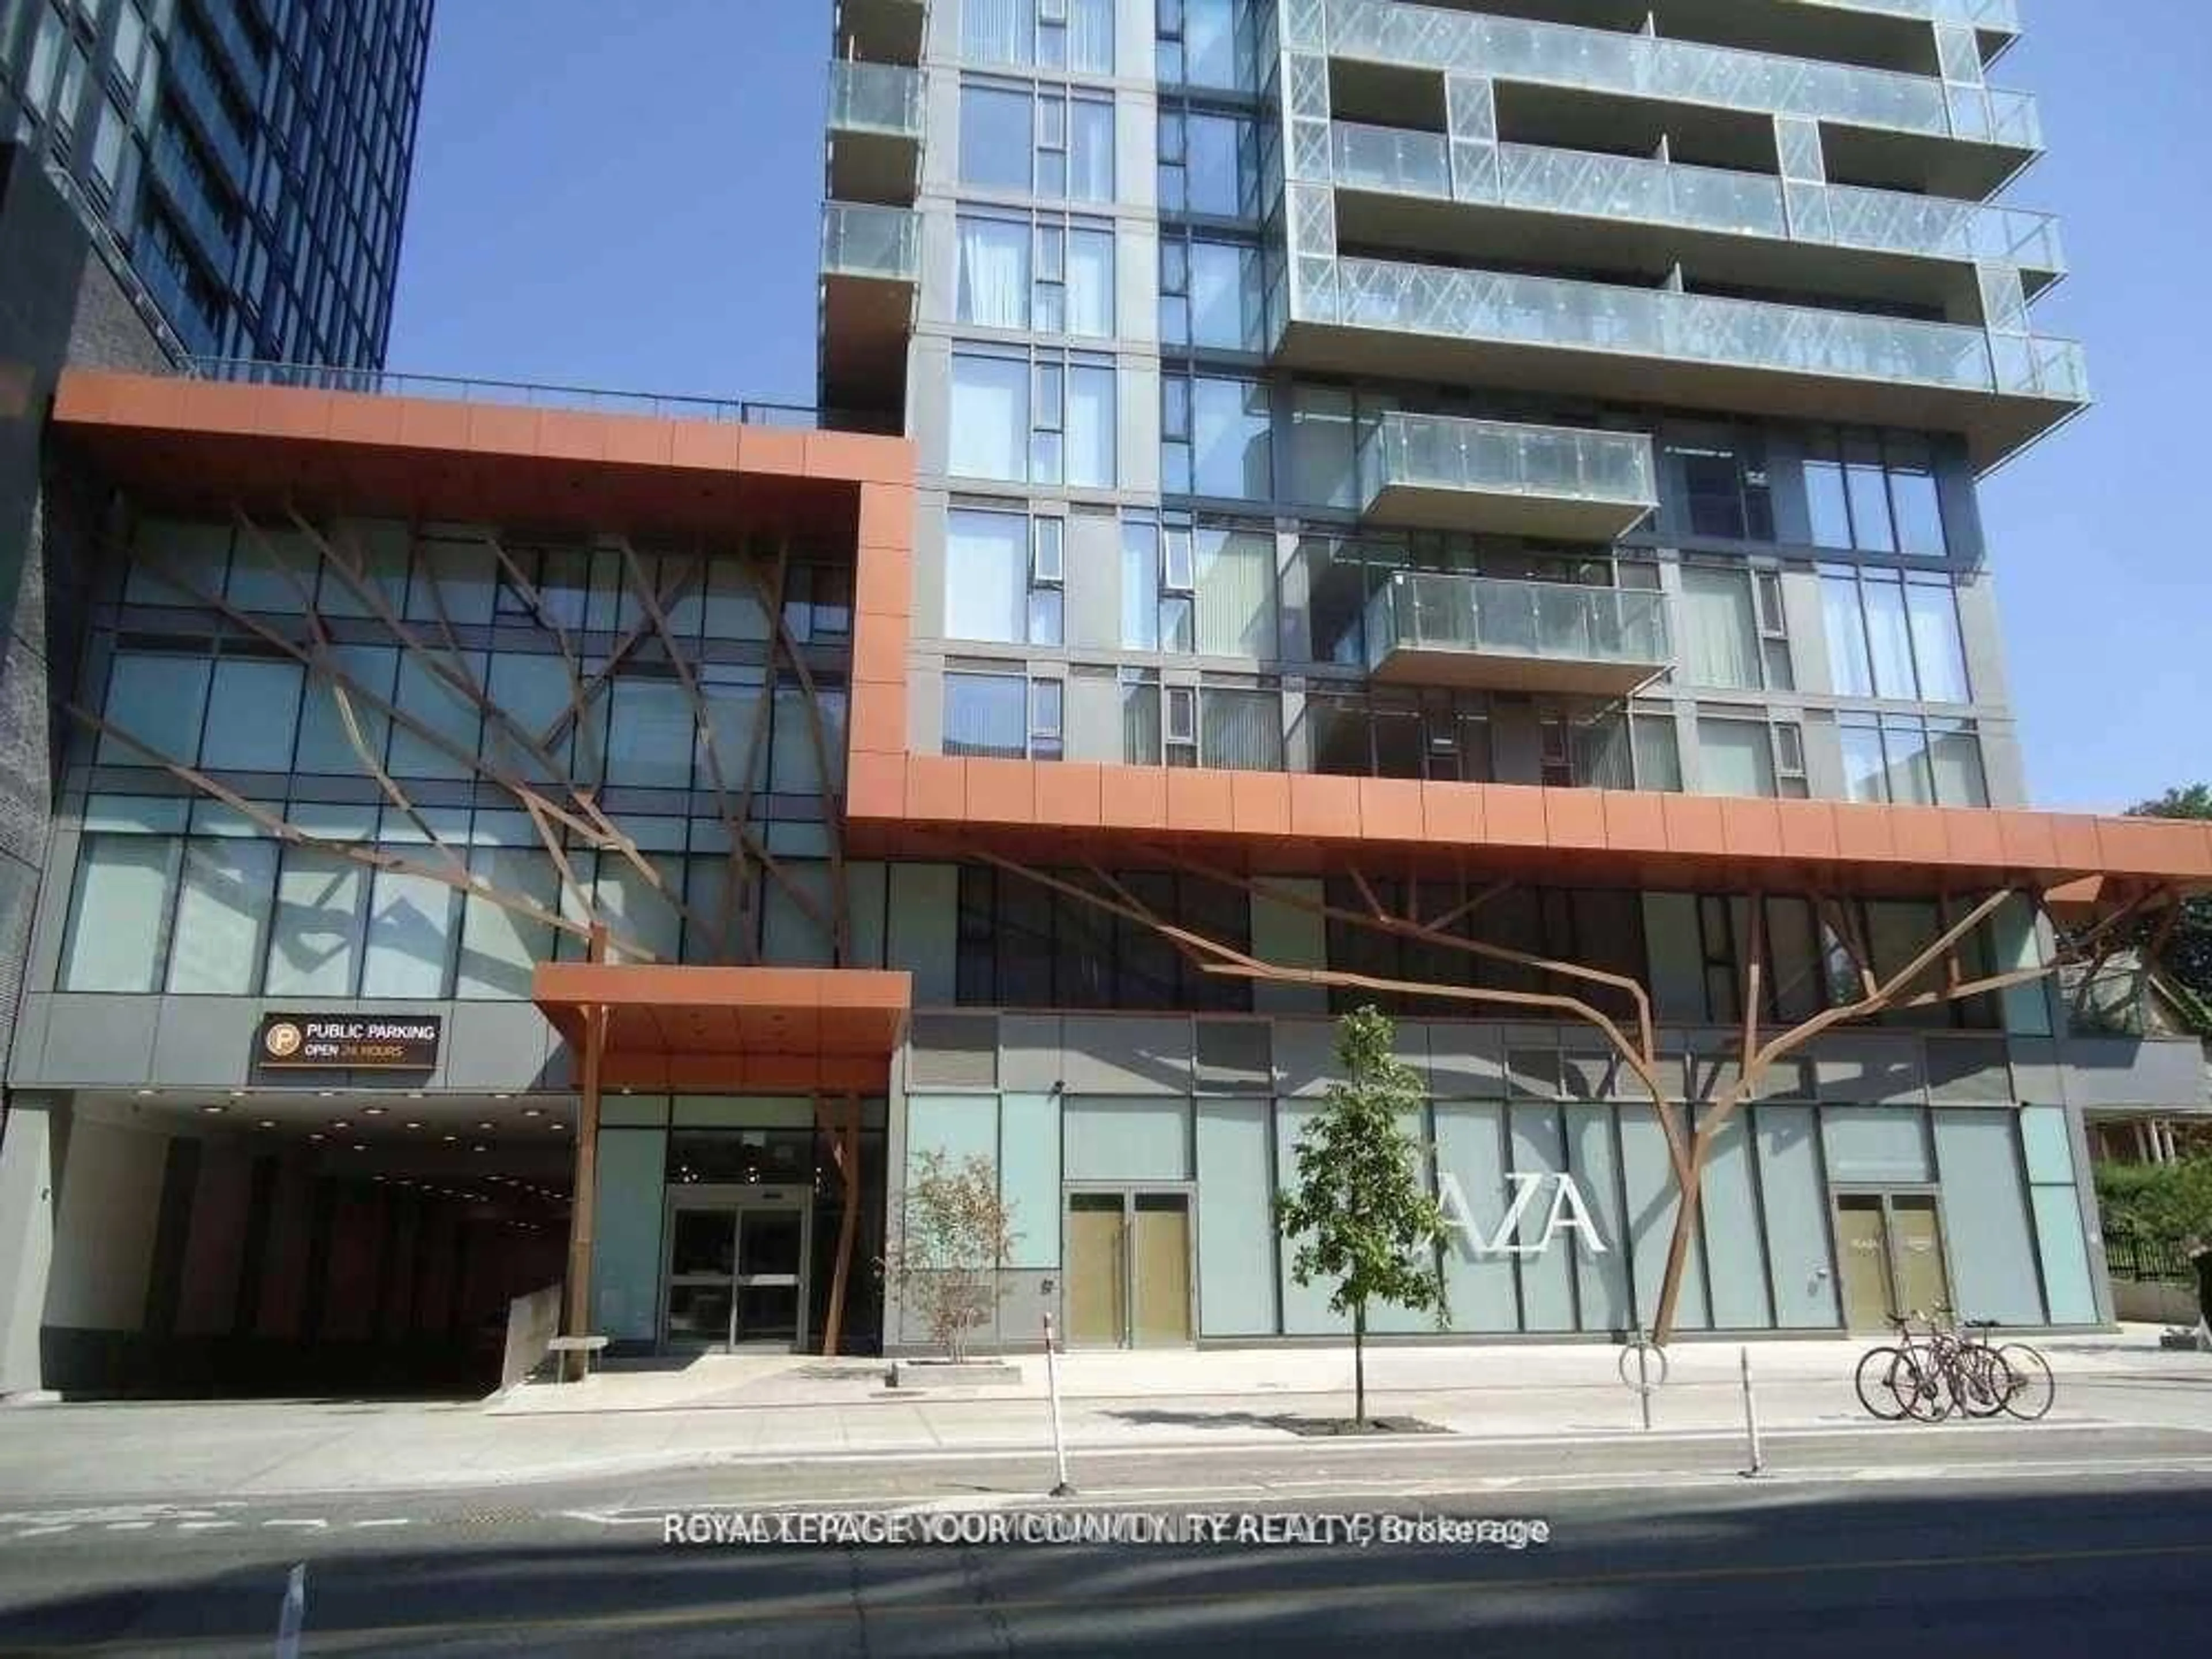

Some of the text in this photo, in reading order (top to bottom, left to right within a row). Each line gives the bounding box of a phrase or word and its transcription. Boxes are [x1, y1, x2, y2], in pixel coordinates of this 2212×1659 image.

[307, 1024, 435, 1040] PUBLIC PARKING
[305, 1044, 339, 1056] OPEN
[361, 1045, 405, 1057] HOURS
